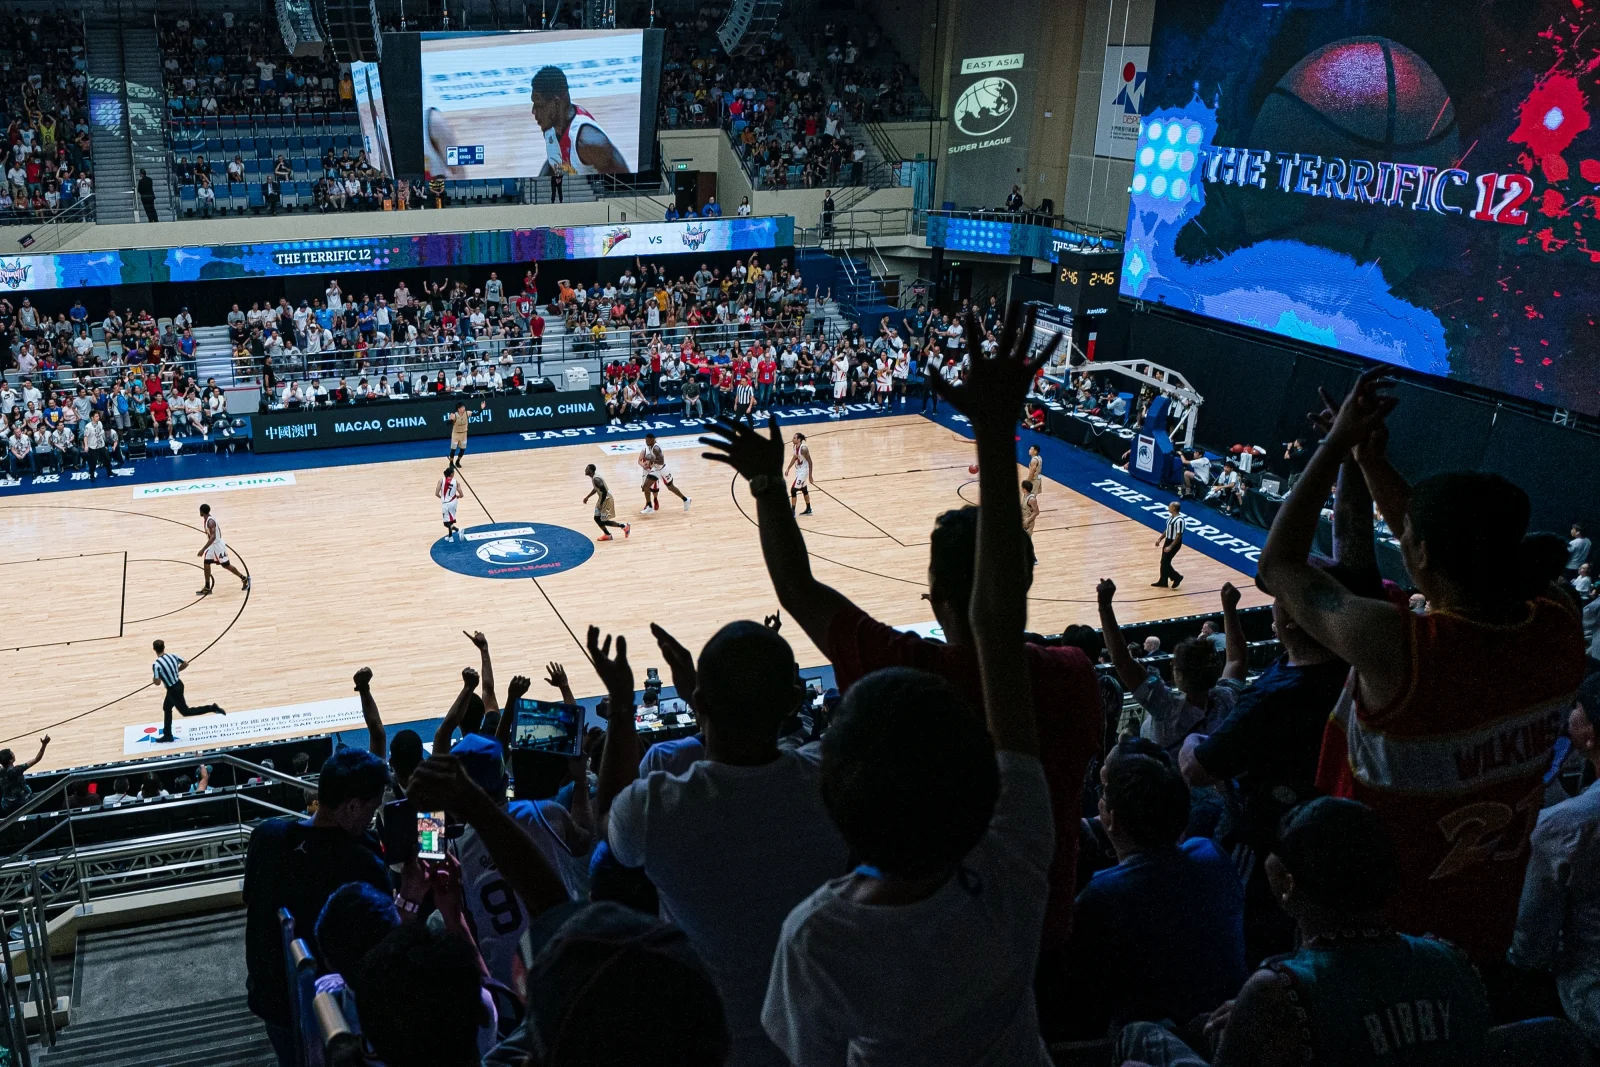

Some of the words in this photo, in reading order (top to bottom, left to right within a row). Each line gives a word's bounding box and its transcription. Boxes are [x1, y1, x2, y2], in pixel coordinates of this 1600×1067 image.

[966, 60, 993, 70] EAST
[996, 57, 1020, 66] ASIA
[948, 142, 977, 154] SUPER
[979, 136, 1012, 149] LEAGUE
[1200, 147, 1270, 190] THE
[1275, 150, 1470, 215] TERRIFIC
[1470, 172, 1534, 226] 12
[276, 252, 301, 265] THE
[302, 249, 357, 264] TERRIFIC
[358, 248, 372, 260] 12
[1060, 268, 1078, 285] 2:46
[1089, 271, 1115, 286] 2:46
[508, 405, 554, 419] MACAO,
[557, 402, 596, 415] CHINA
[265, 423, 318, 440] 中國澳門
[334, 419, 383, 433] MACAO,
[387, 416, 427, 429] CHINA
[519, 427, 597, 441] EAST
[606, 420, 676, 434] ASIA
[144, 483, 220, 495] MACAO,
[225, 476, 287, 487] CHINA
[1091, 478, 1153, 504] THE
[488, 566, 521, 575] SUPER
[523, 562, 561, 571] LEAGUE
[189, 734, 217, 742] Sports
